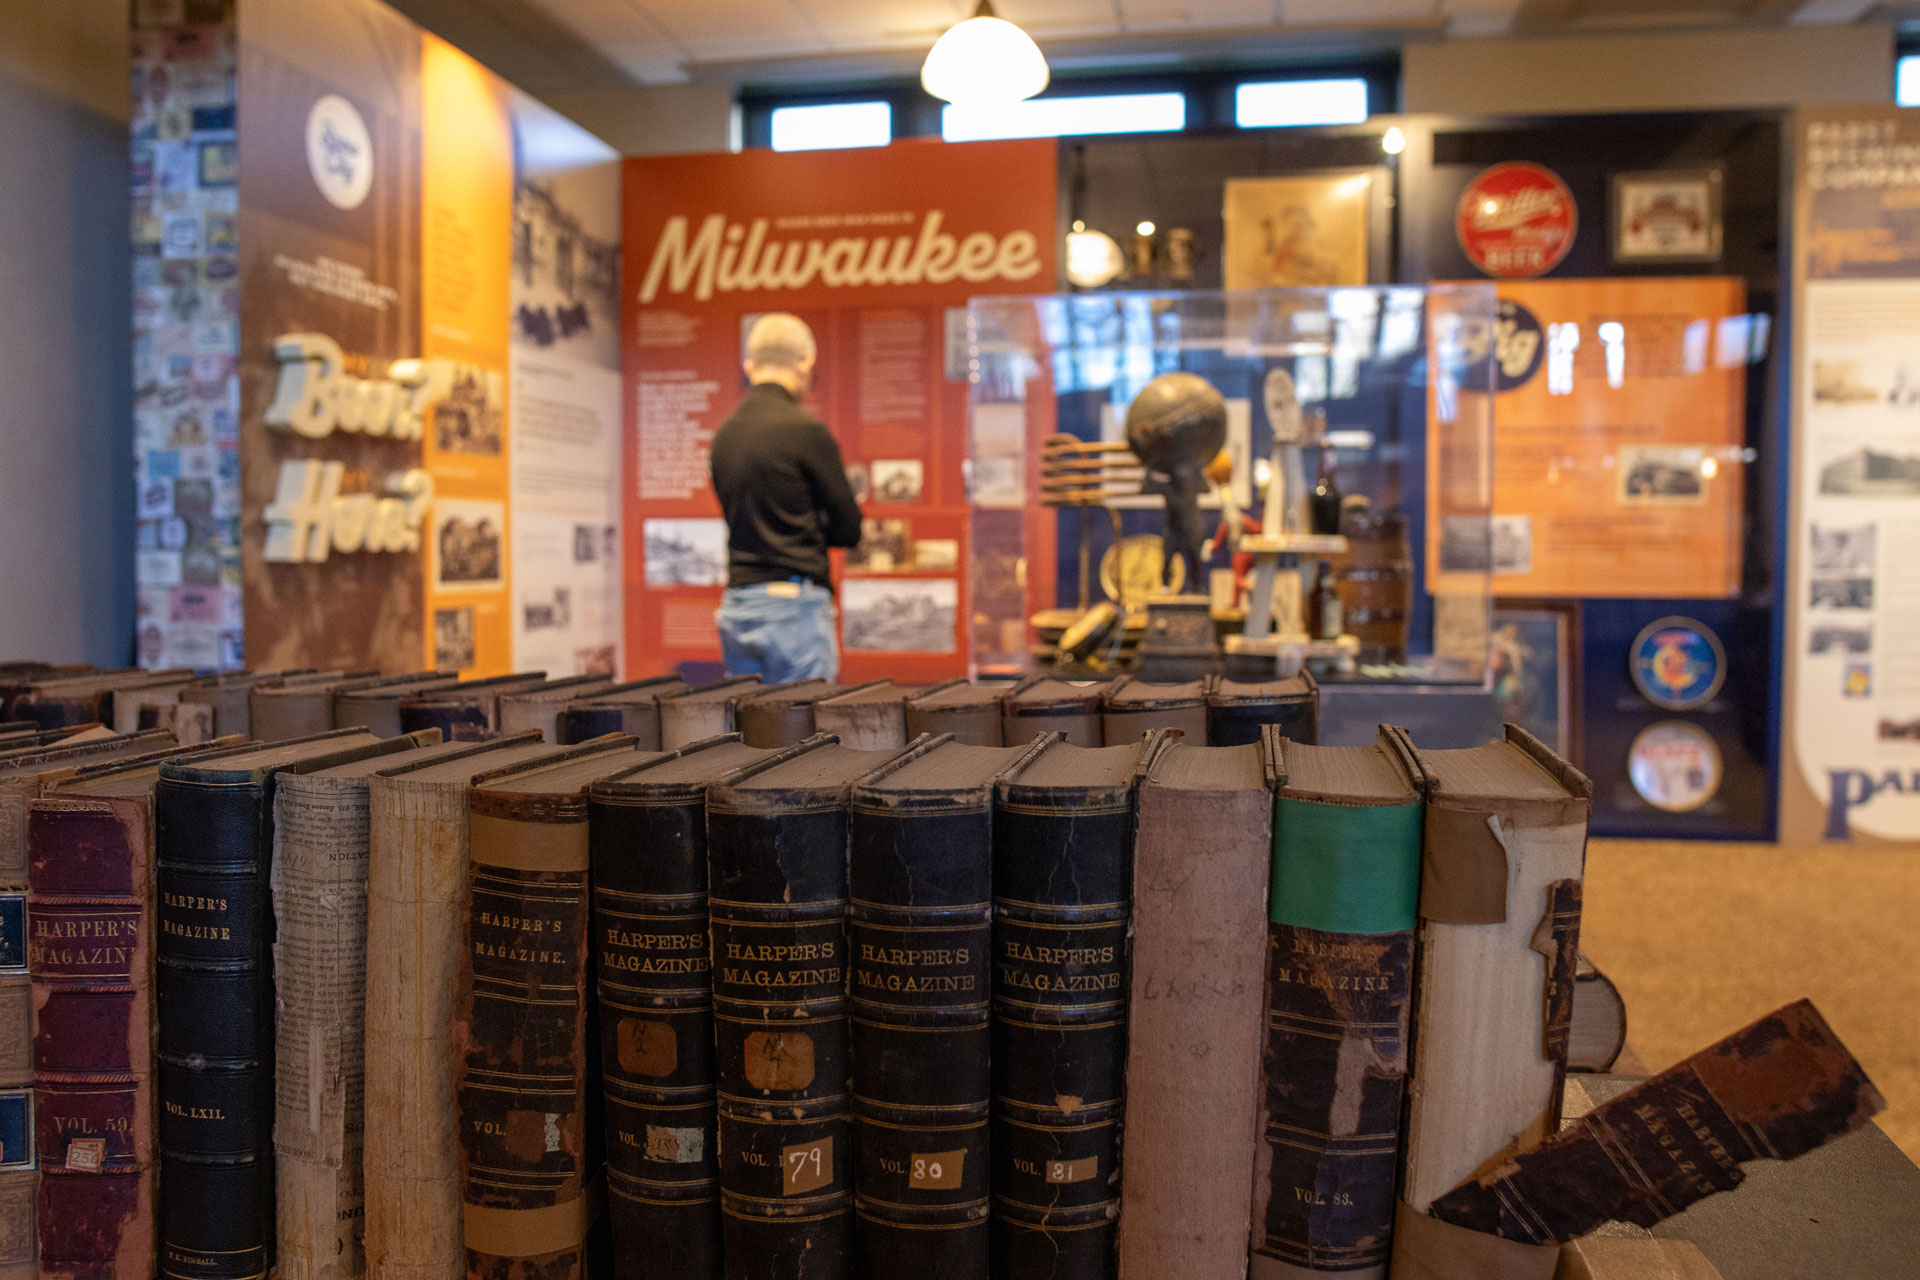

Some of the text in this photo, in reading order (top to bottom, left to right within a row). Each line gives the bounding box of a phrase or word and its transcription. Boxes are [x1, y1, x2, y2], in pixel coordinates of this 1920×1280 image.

[638, 210, 1043, 304] Milwaukee
[164, 892, 228, 911] HARPER'S
[36, 919, 138, 938] HARPER'S
[163, 920, 230, 940] MAGAZINE
[482, 912, 562, 932] HARPER'S
[608, 929, 703, 949] HARPER'S
[476, 942, 567, 964] MAGAZINE.
[727, 942, 834, 962] HARPER'S
[860, 944, 970, 966] HARPER'S
[1006, 941, 1114, 965] HARPER'S
[603, 952, 708, 973] MAGAZINE
[723, 967, 841, 987] MAGAZINE
[858, 970, 975, 992] MAGAZINE
[1003, 968, 1120, 992] MAGAZINE
[1279, 969, 1390, 991] MAGAZINE
[166, 1101, 225, 1120] VOL. LXII.
[54, 1116, 98, 1134] VOL.
[473, 1120, 507, 1136] VOL.
[619, 1129, 640, 1148] VOL.
[741, 1151, 770, 1167] VOL.
[788, 1147, 821, 1184] 79
[1014, 1158, 1041, 1176] VOL.
[913, 1159, 943, 1181] 80
